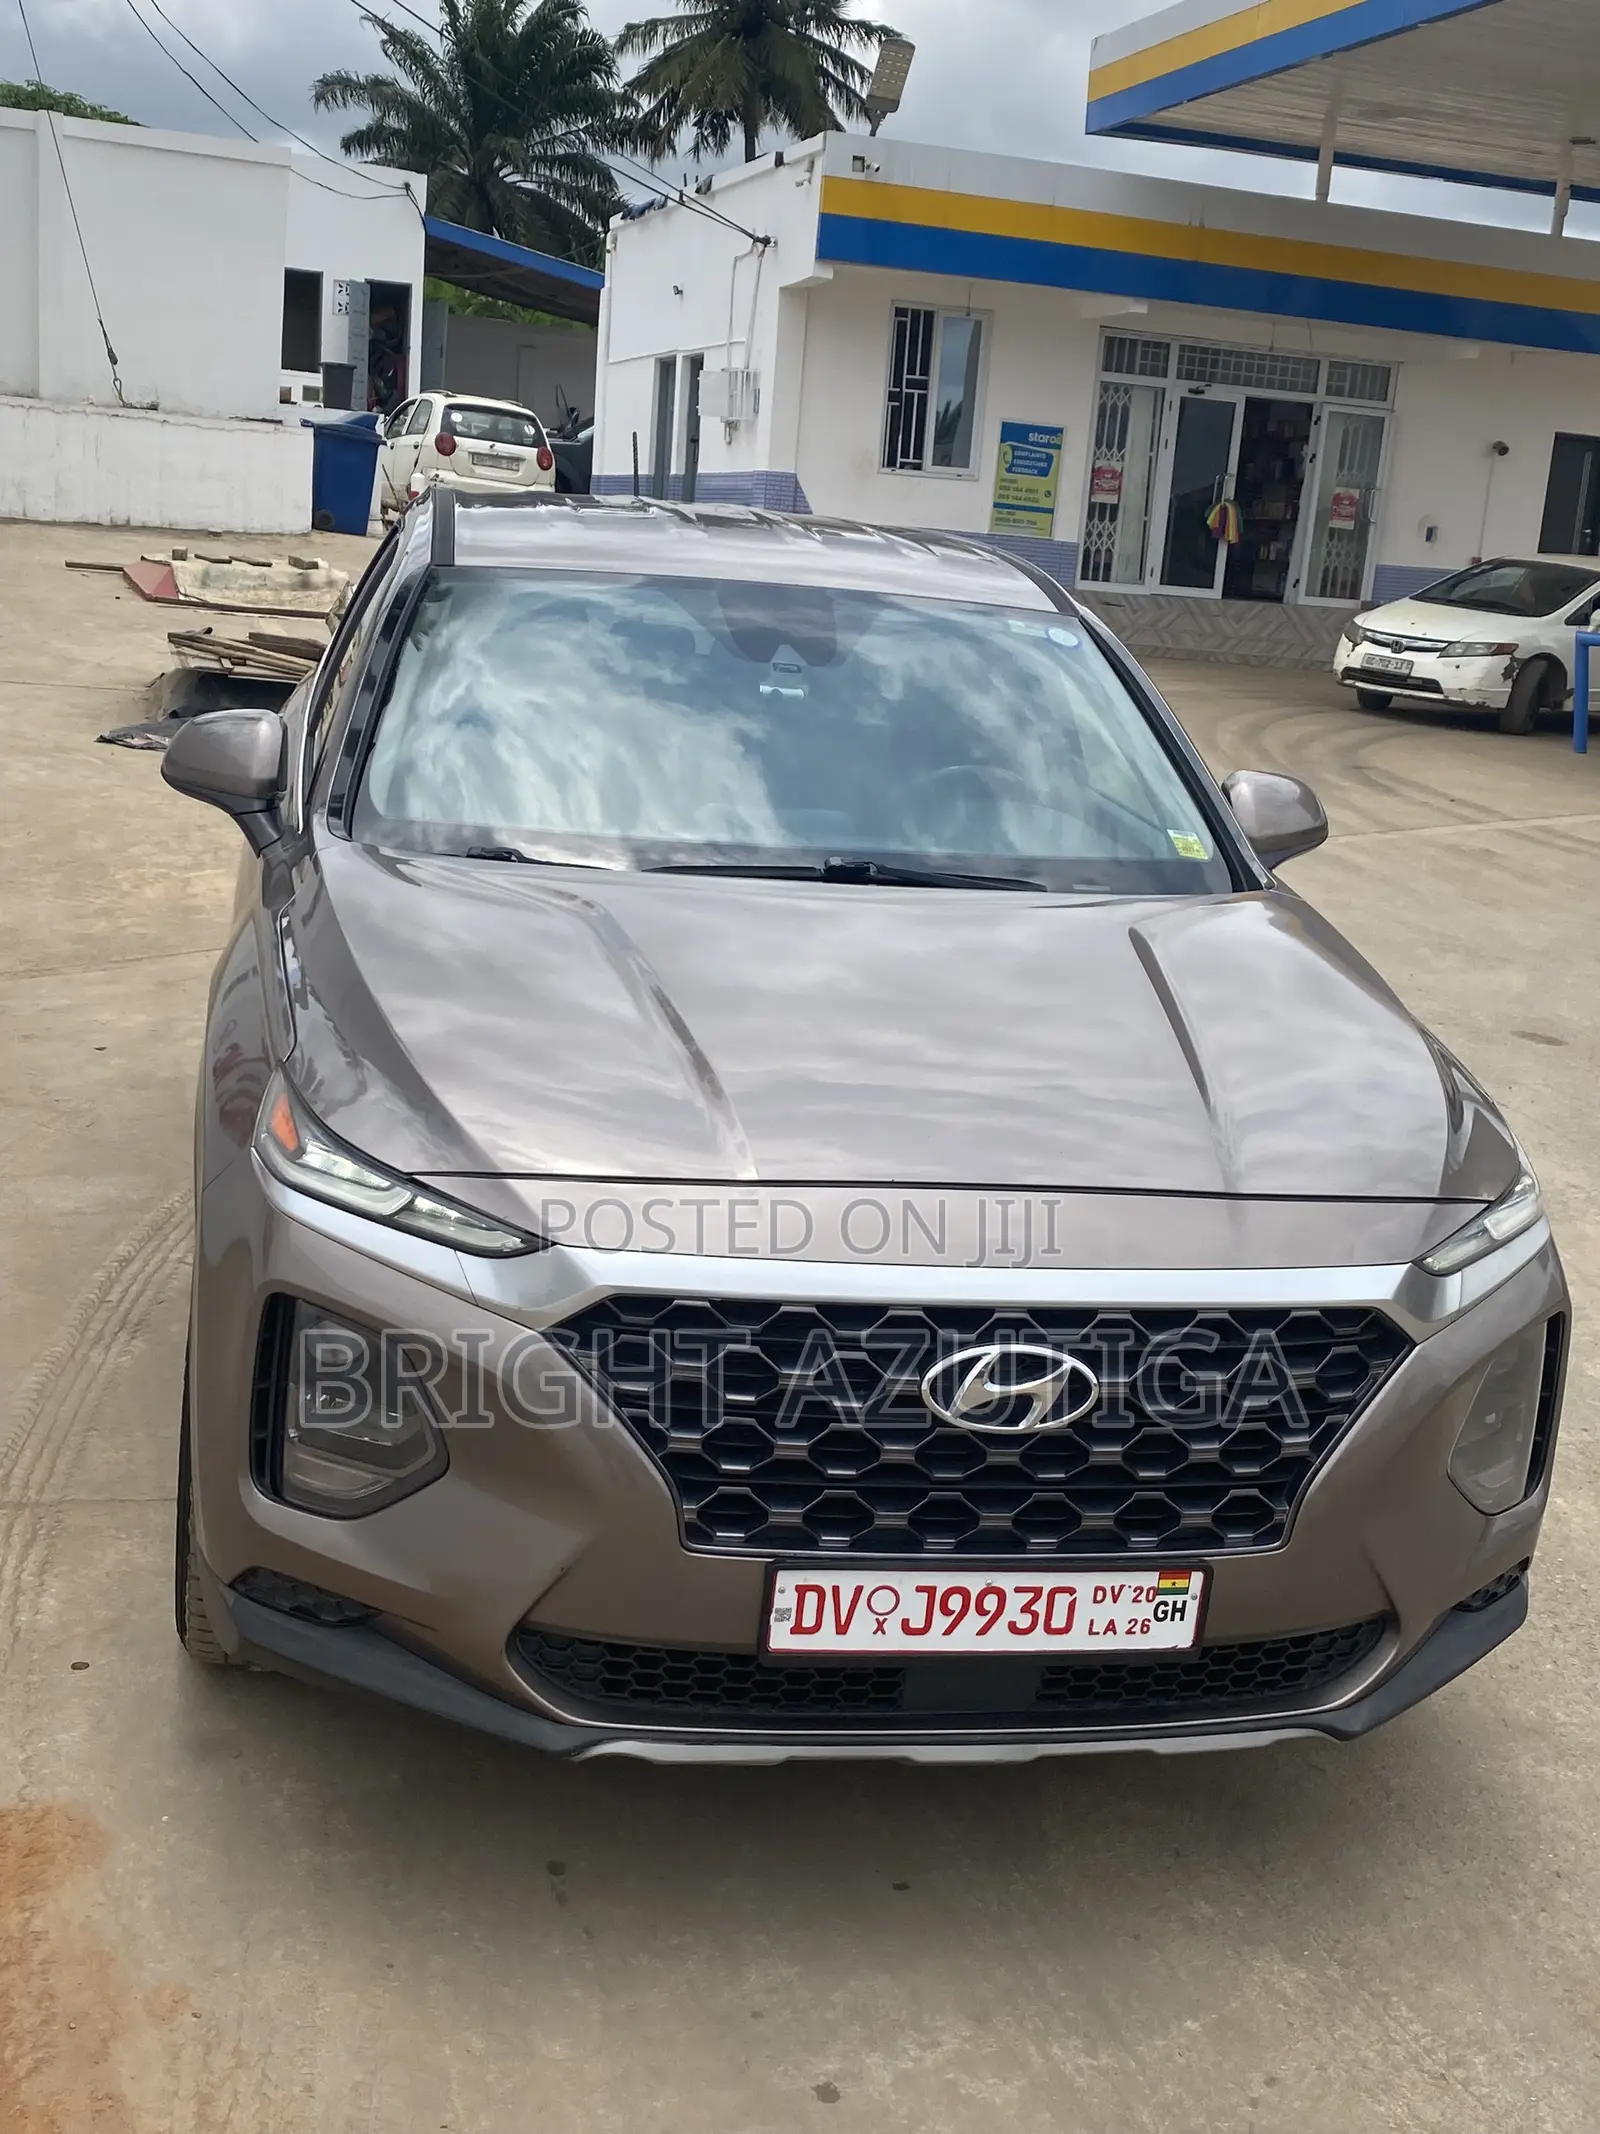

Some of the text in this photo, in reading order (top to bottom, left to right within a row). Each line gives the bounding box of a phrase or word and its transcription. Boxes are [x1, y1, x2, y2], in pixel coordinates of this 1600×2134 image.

[790, 1584, 1078, 1636] DV J9930
[1153, 1599, 1187, 1622] GH
[1125, 1618, 1151, 1635] 26
